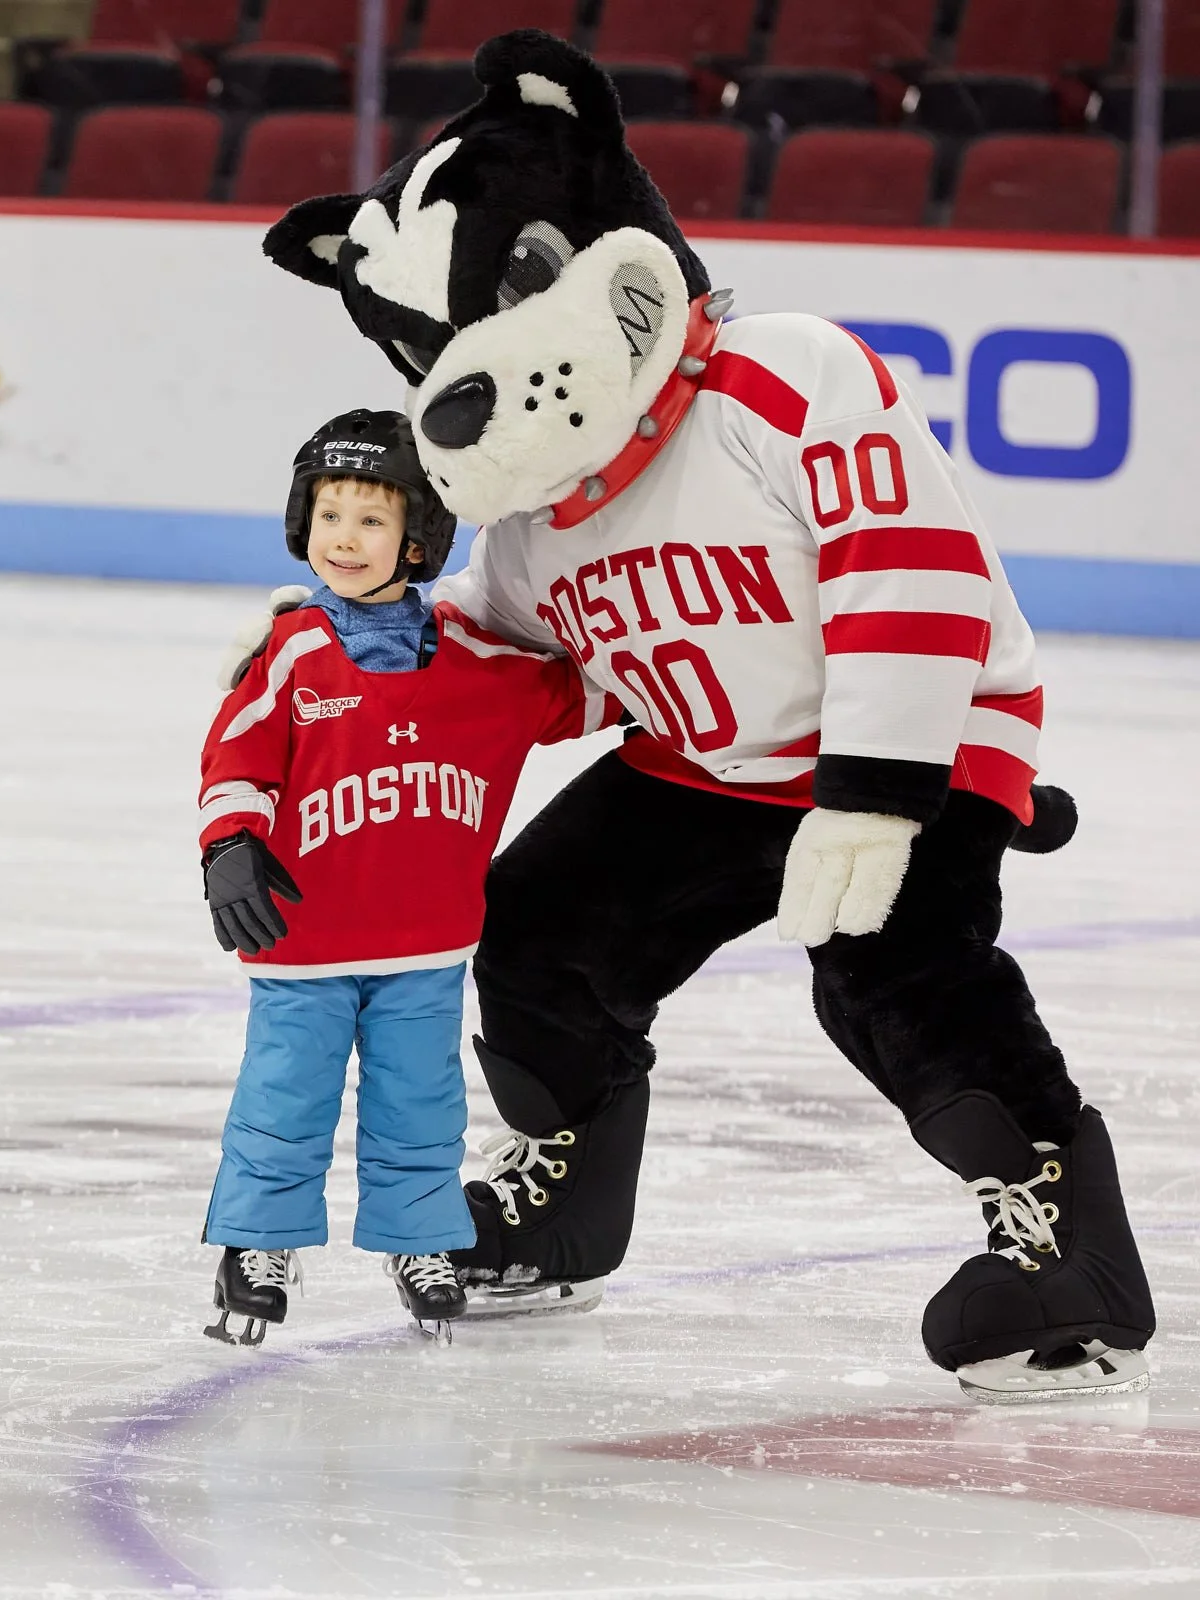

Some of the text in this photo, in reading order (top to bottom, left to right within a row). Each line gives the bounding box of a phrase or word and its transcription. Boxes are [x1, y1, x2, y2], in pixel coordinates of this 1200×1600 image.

[323, 441, 387, 454] BAUER
[801, 433, 908, 529] 00
[320, 698, 359, 709] HOCKEY
[320, 707, 343, 716] EAST
[611, 639, 738, 754] 00
[299, 762, 488, 858] BOSTON
